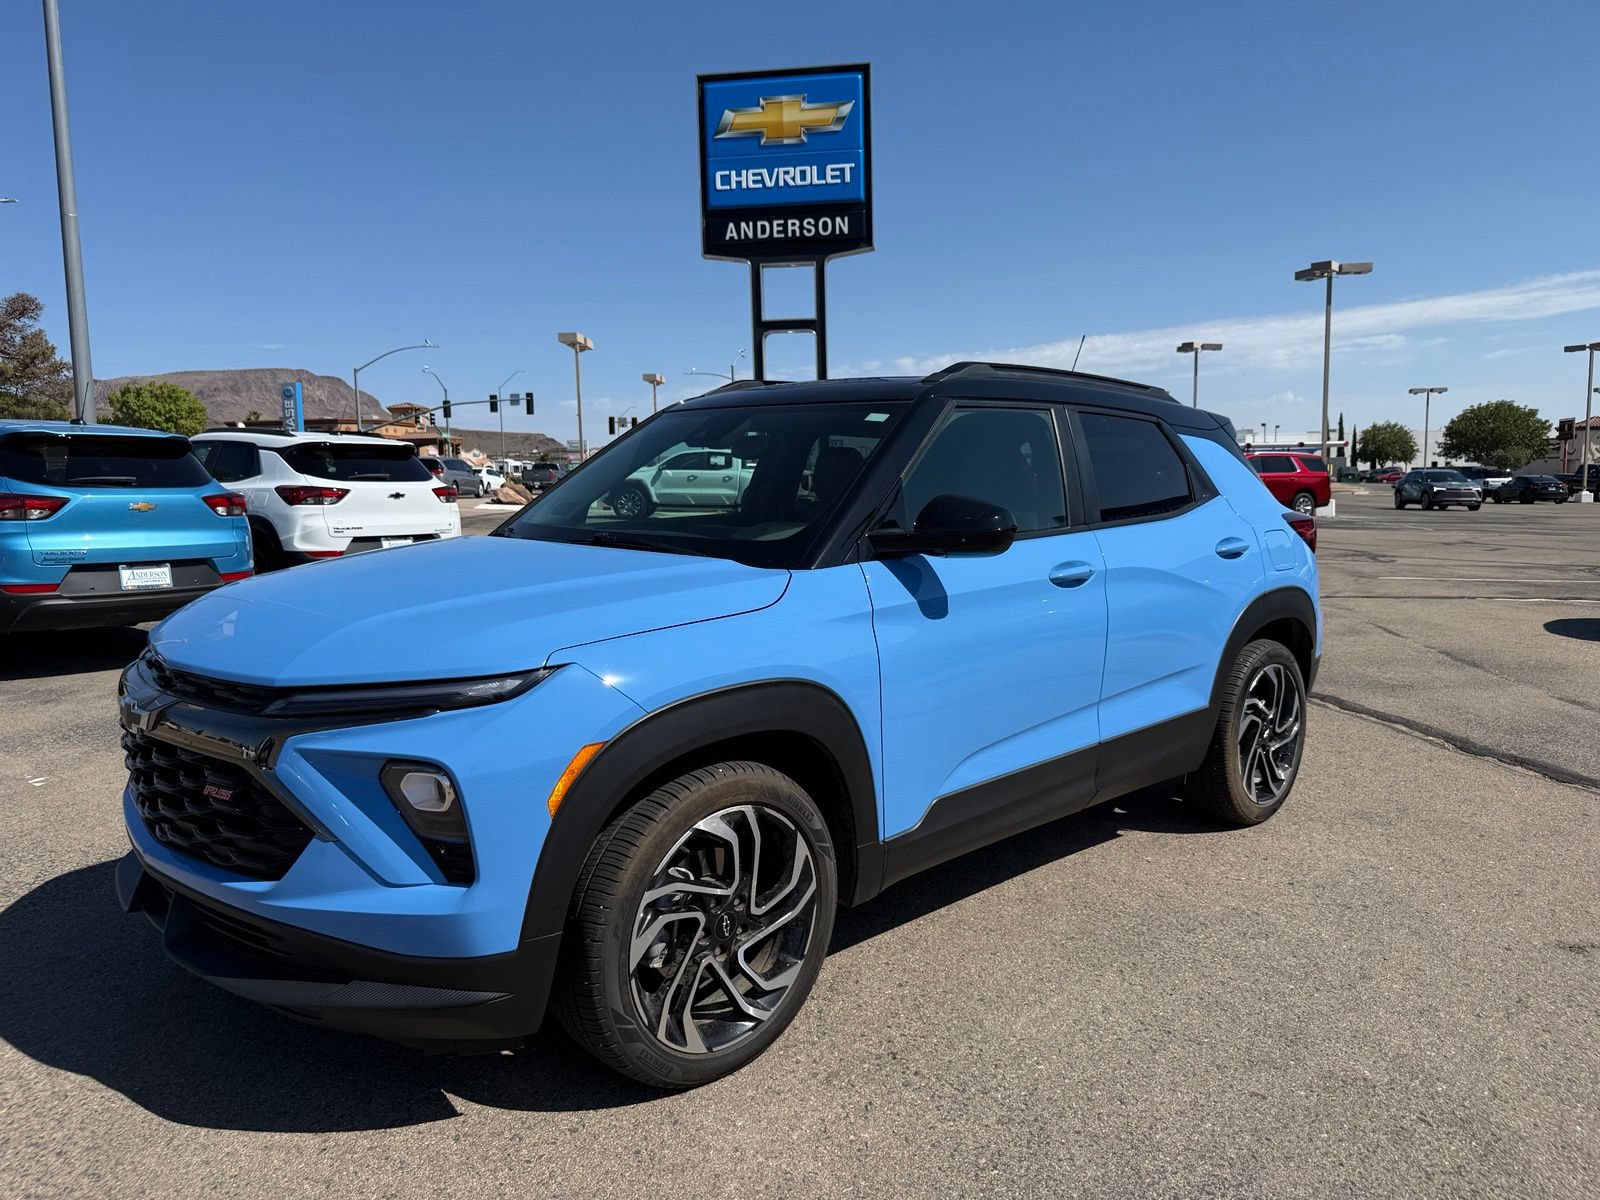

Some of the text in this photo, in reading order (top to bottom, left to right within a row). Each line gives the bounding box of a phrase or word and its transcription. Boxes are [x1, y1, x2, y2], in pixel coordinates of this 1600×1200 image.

[715, 163, 855, 190] CHEVROLET
[725, 216, 849, 240] ANDERSON
[284, 400, 295, 433] HASE
[126, 570, 168, 584] ANDERSON
[203, 785, 233, 800] RS
